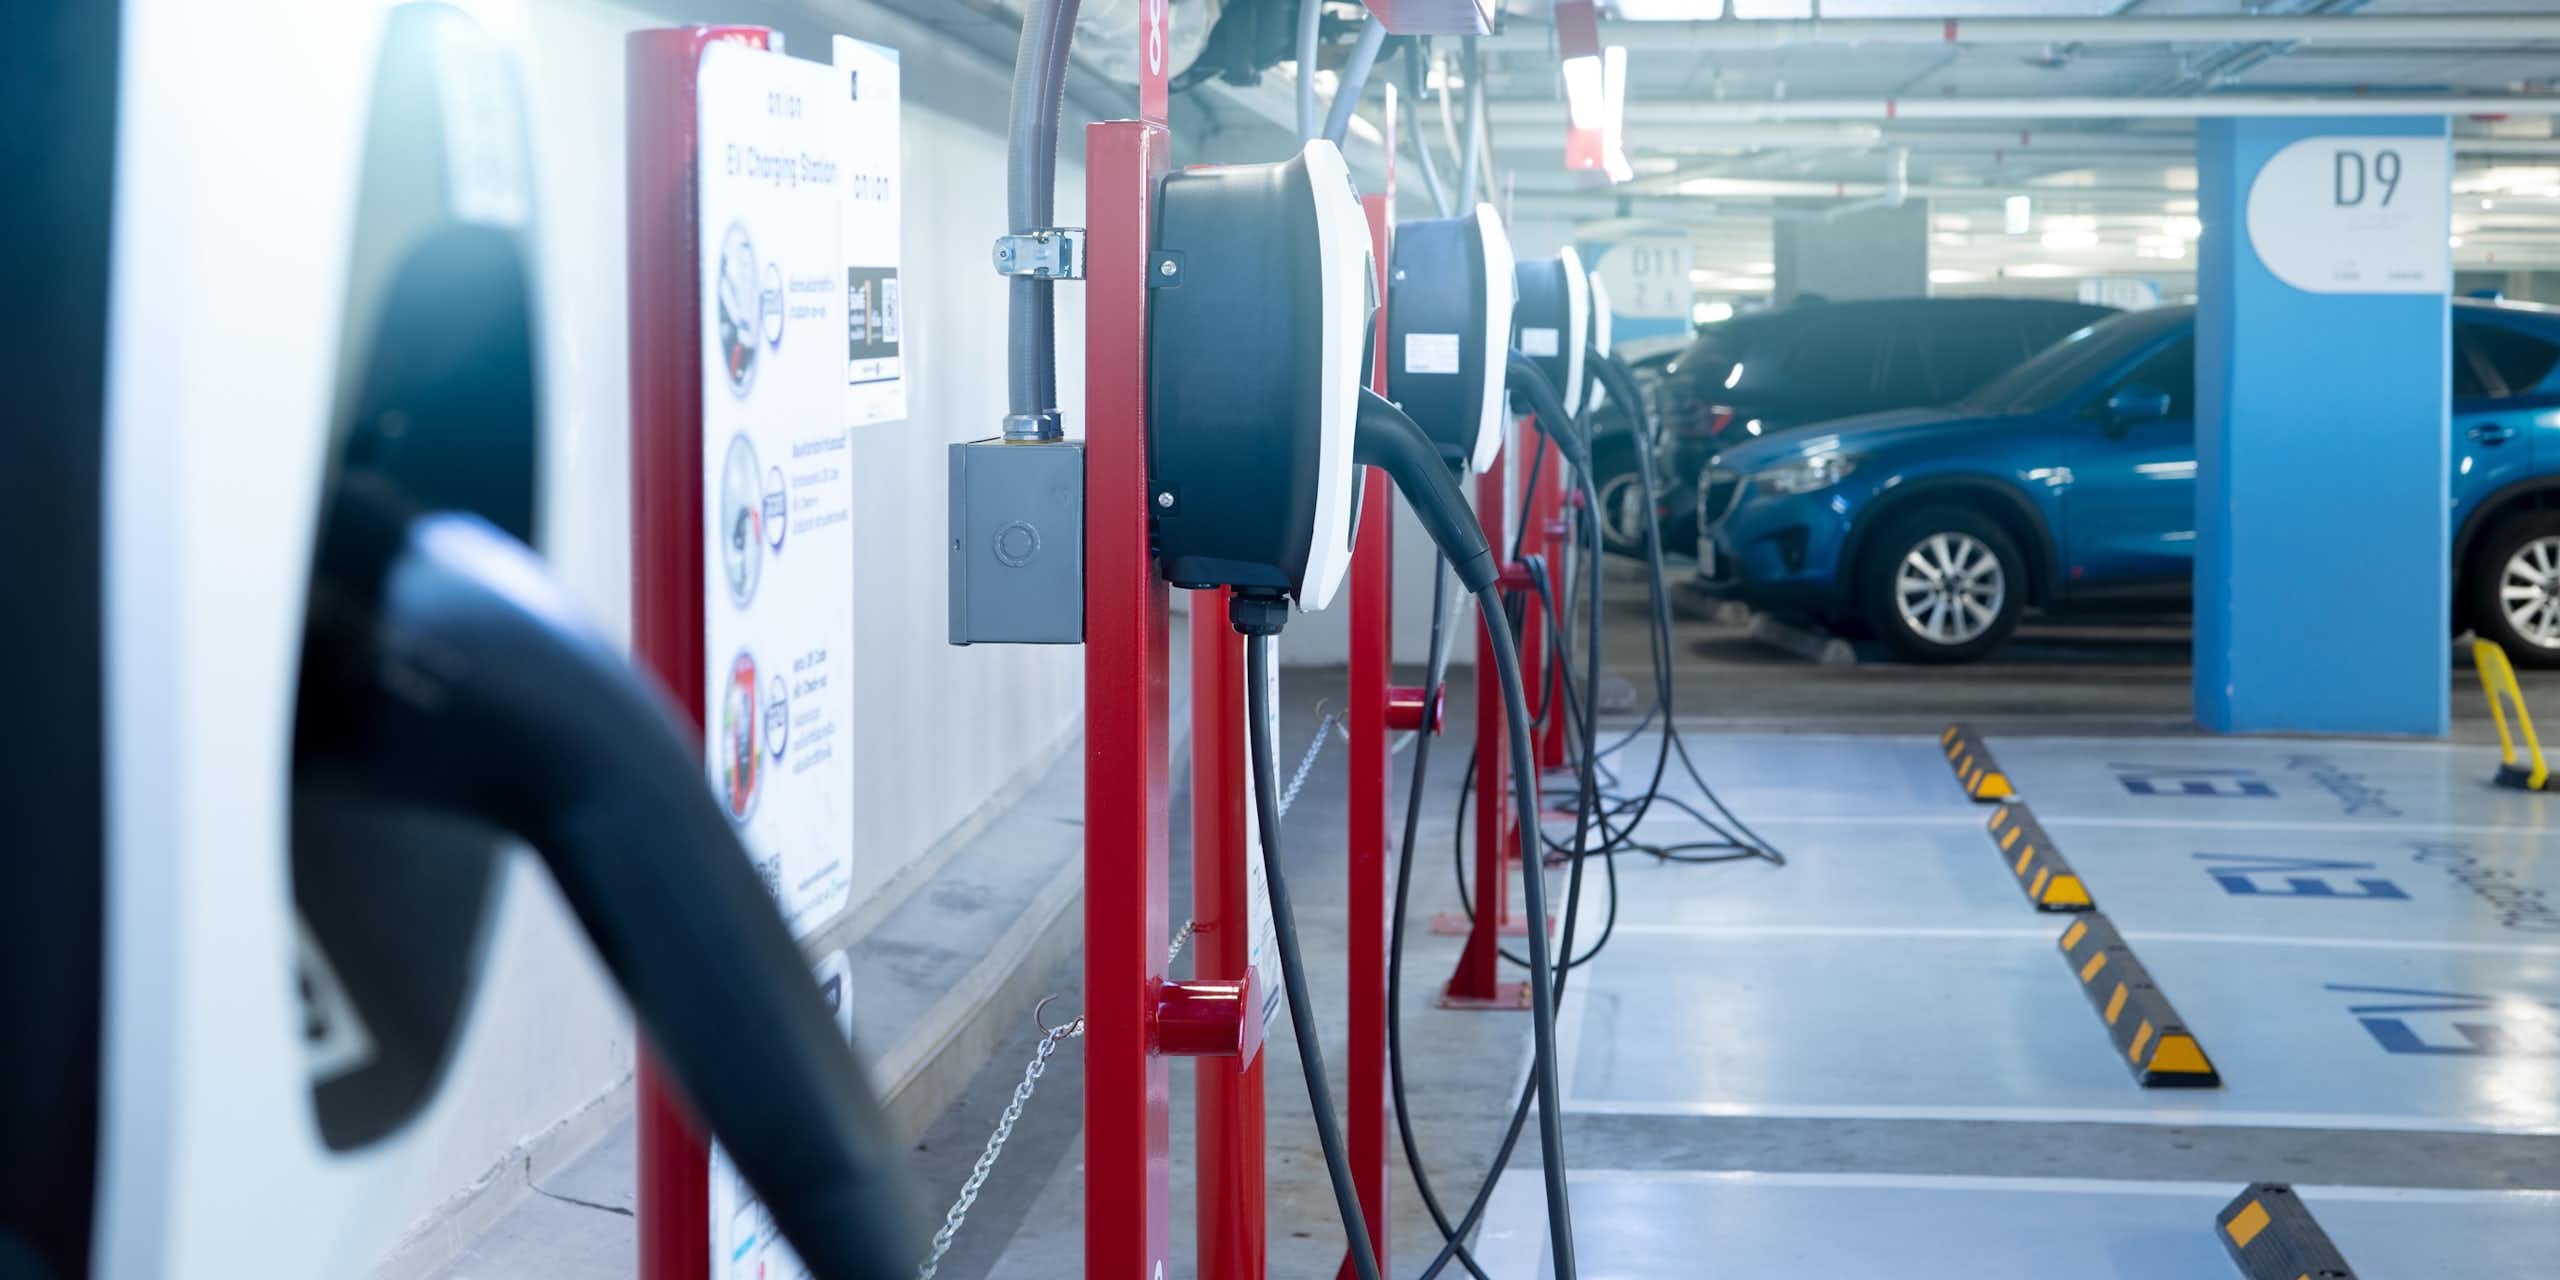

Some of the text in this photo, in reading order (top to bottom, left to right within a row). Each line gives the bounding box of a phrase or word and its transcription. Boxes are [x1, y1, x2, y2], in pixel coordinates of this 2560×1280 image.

[748, 146, 797, 188] Charging
[2334, 149, 2402, 207] D9
[1632, 247, 1680, 278] D11
[2108, 762, 2280, 797] EV
[2192, 852, 2414, 901] EV
